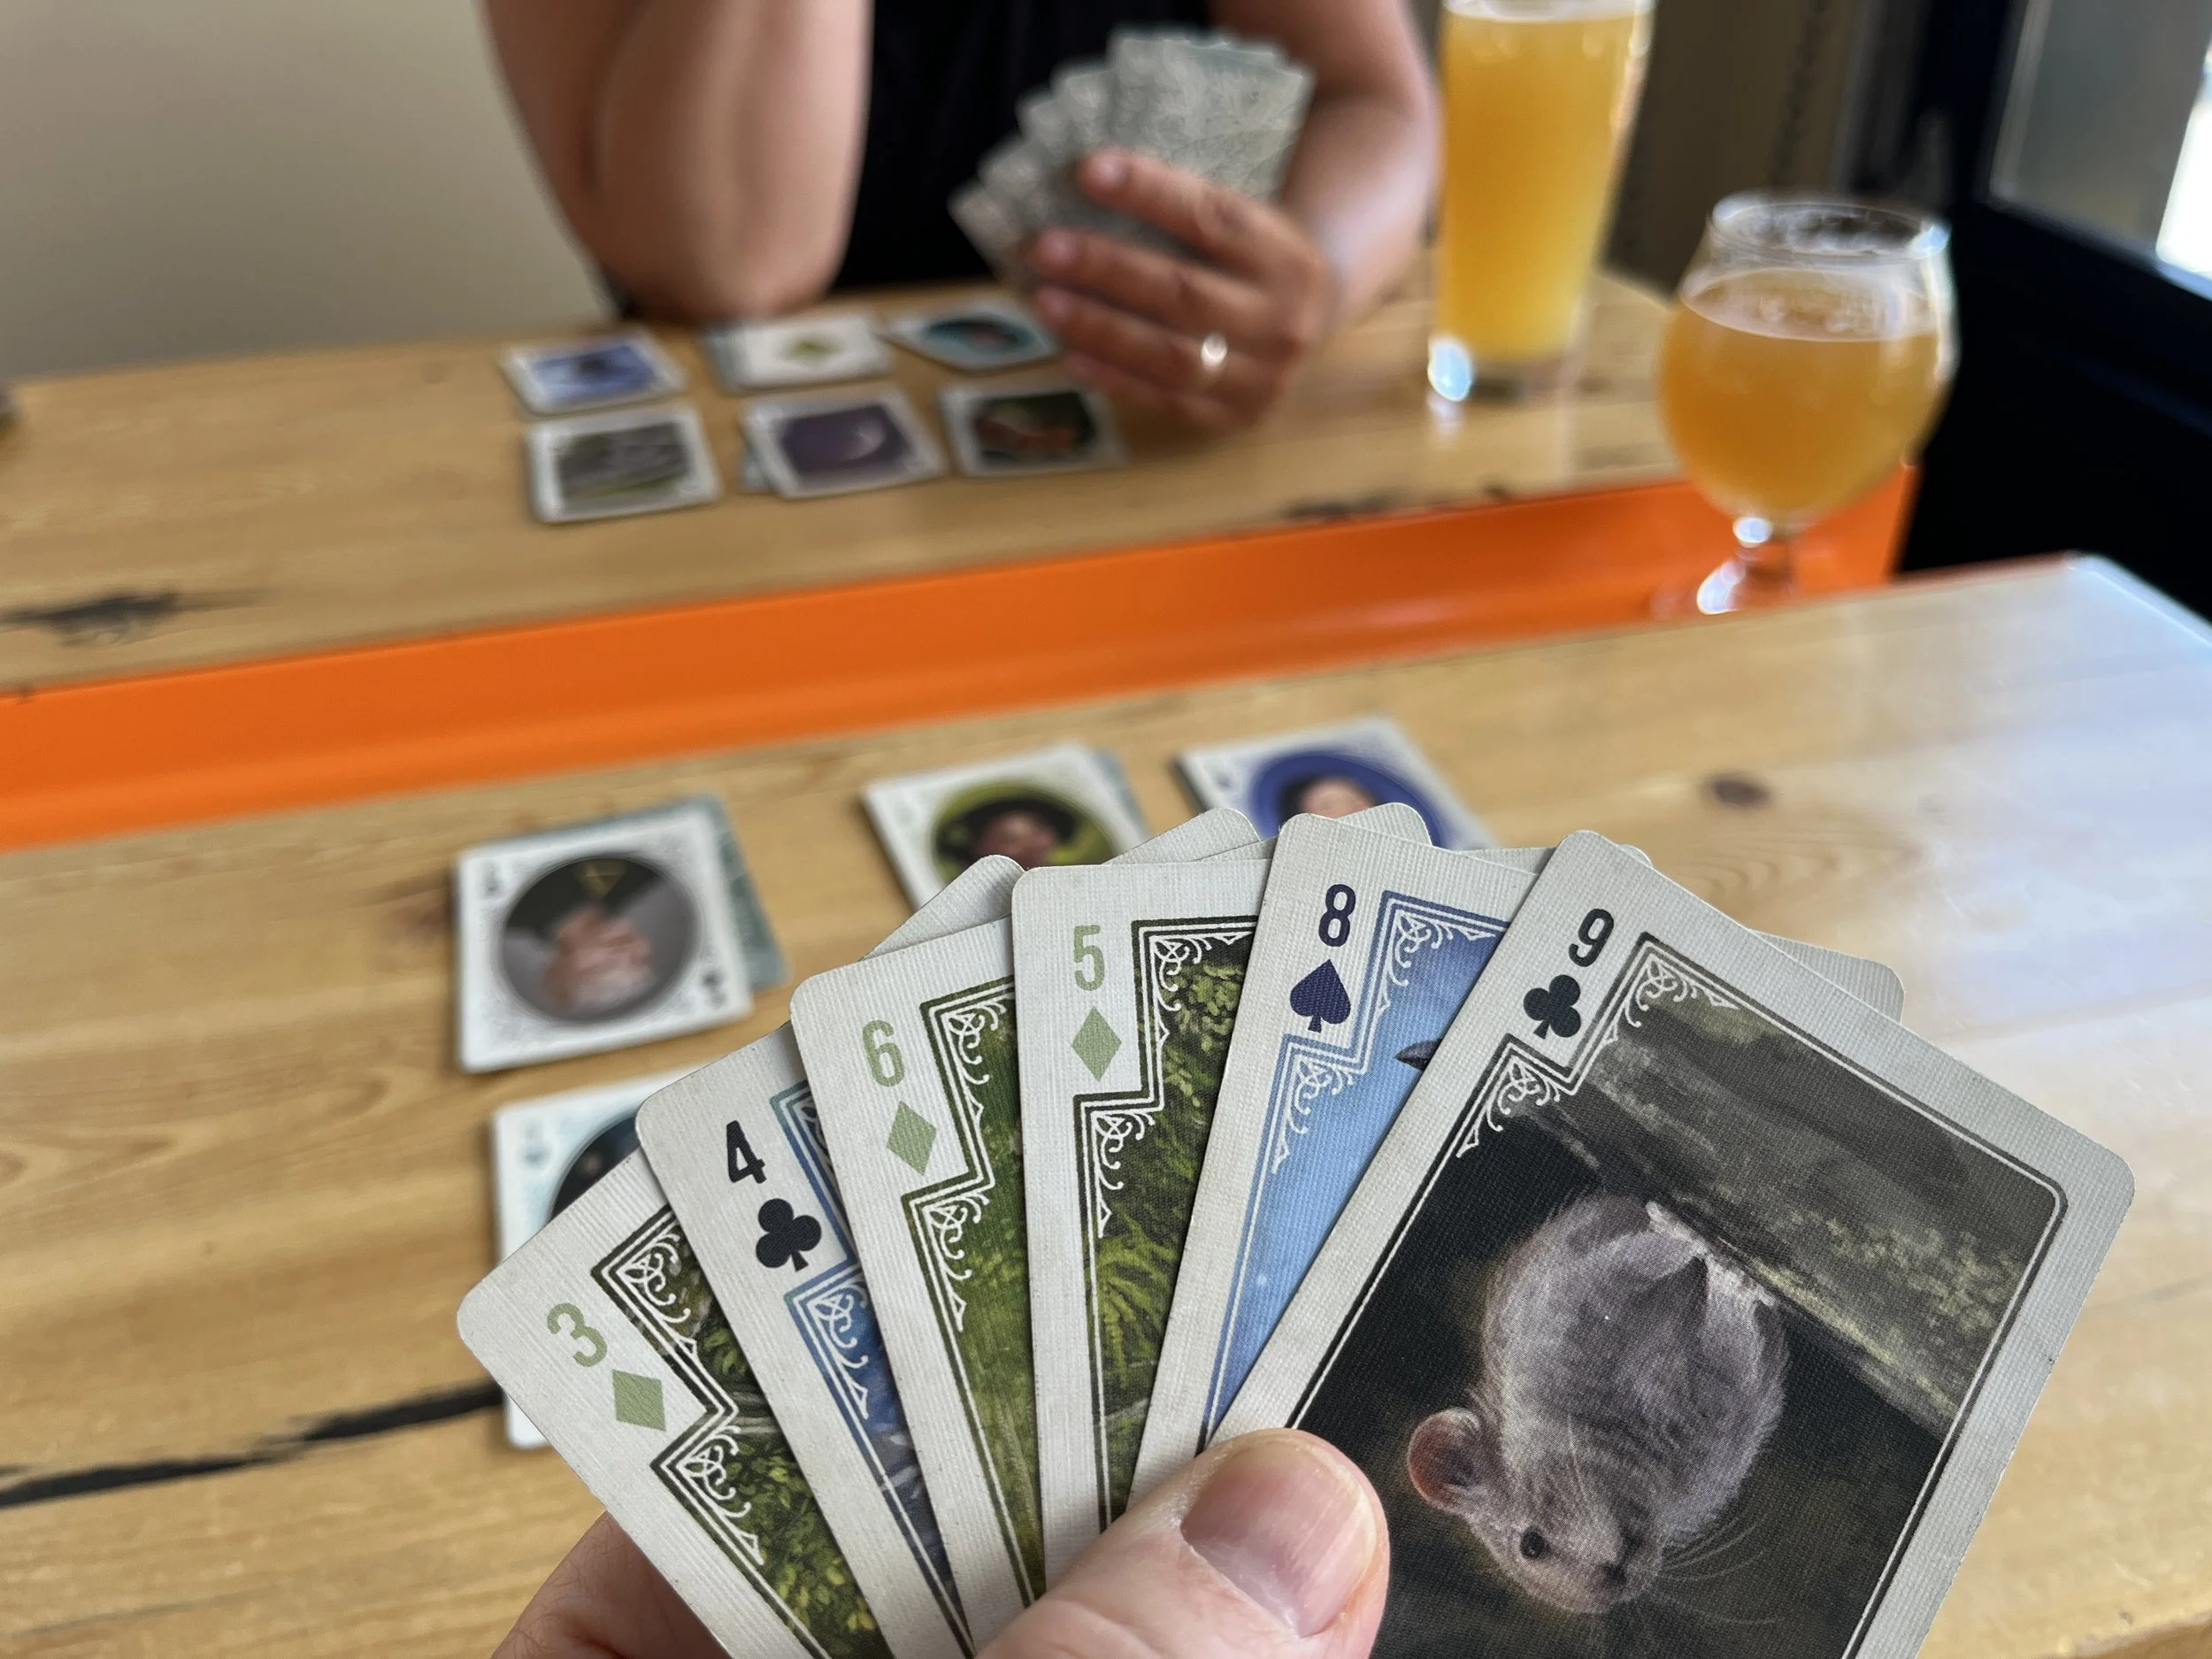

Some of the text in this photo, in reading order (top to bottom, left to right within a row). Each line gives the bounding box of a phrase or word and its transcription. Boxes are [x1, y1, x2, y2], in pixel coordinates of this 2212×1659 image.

[1318, 884, 1356, 948] 8
[1568, 908, 1615, 968] 9
[1072, 925, 1105, 991] 5
[862, 1019, 905, 1087] 6
[725, 1120, 766, 1185] 4
[546, 1302, 608, 1368] 3
